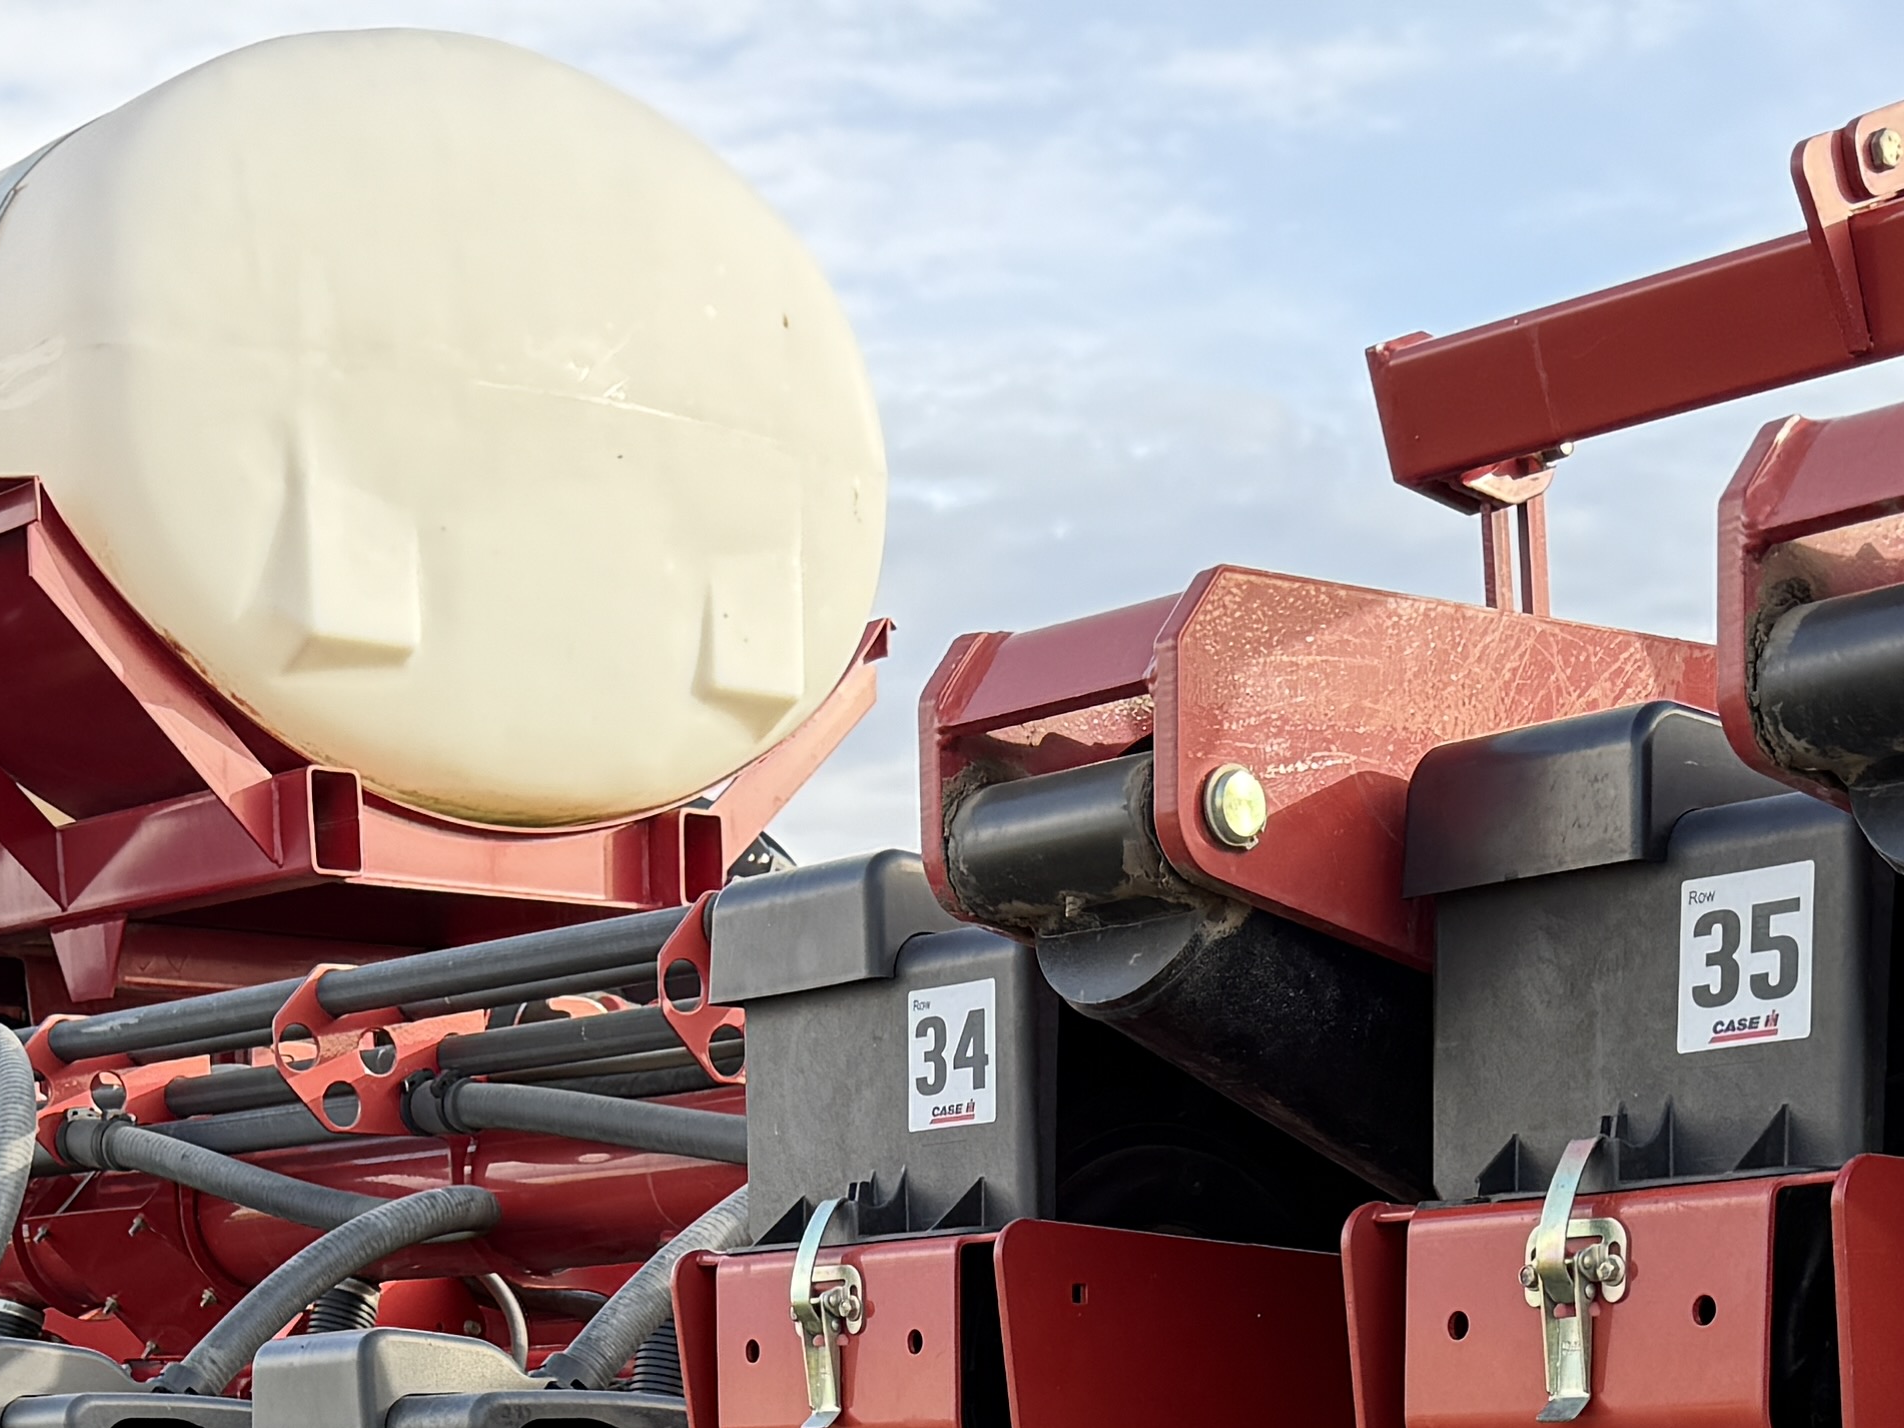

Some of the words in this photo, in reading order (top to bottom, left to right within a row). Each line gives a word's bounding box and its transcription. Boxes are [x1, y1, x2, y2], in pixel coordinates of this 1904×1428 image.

[1688, 889, 1716, 905] Row
[1691, 896, 1801, 1009] 35
[912, 1000, 931, 1012] Row
[1712, 1015, 1761, 1035] CASE
[915, 1007, 989, 1096] 34
[931, 1103, 963, 1118] CASE
